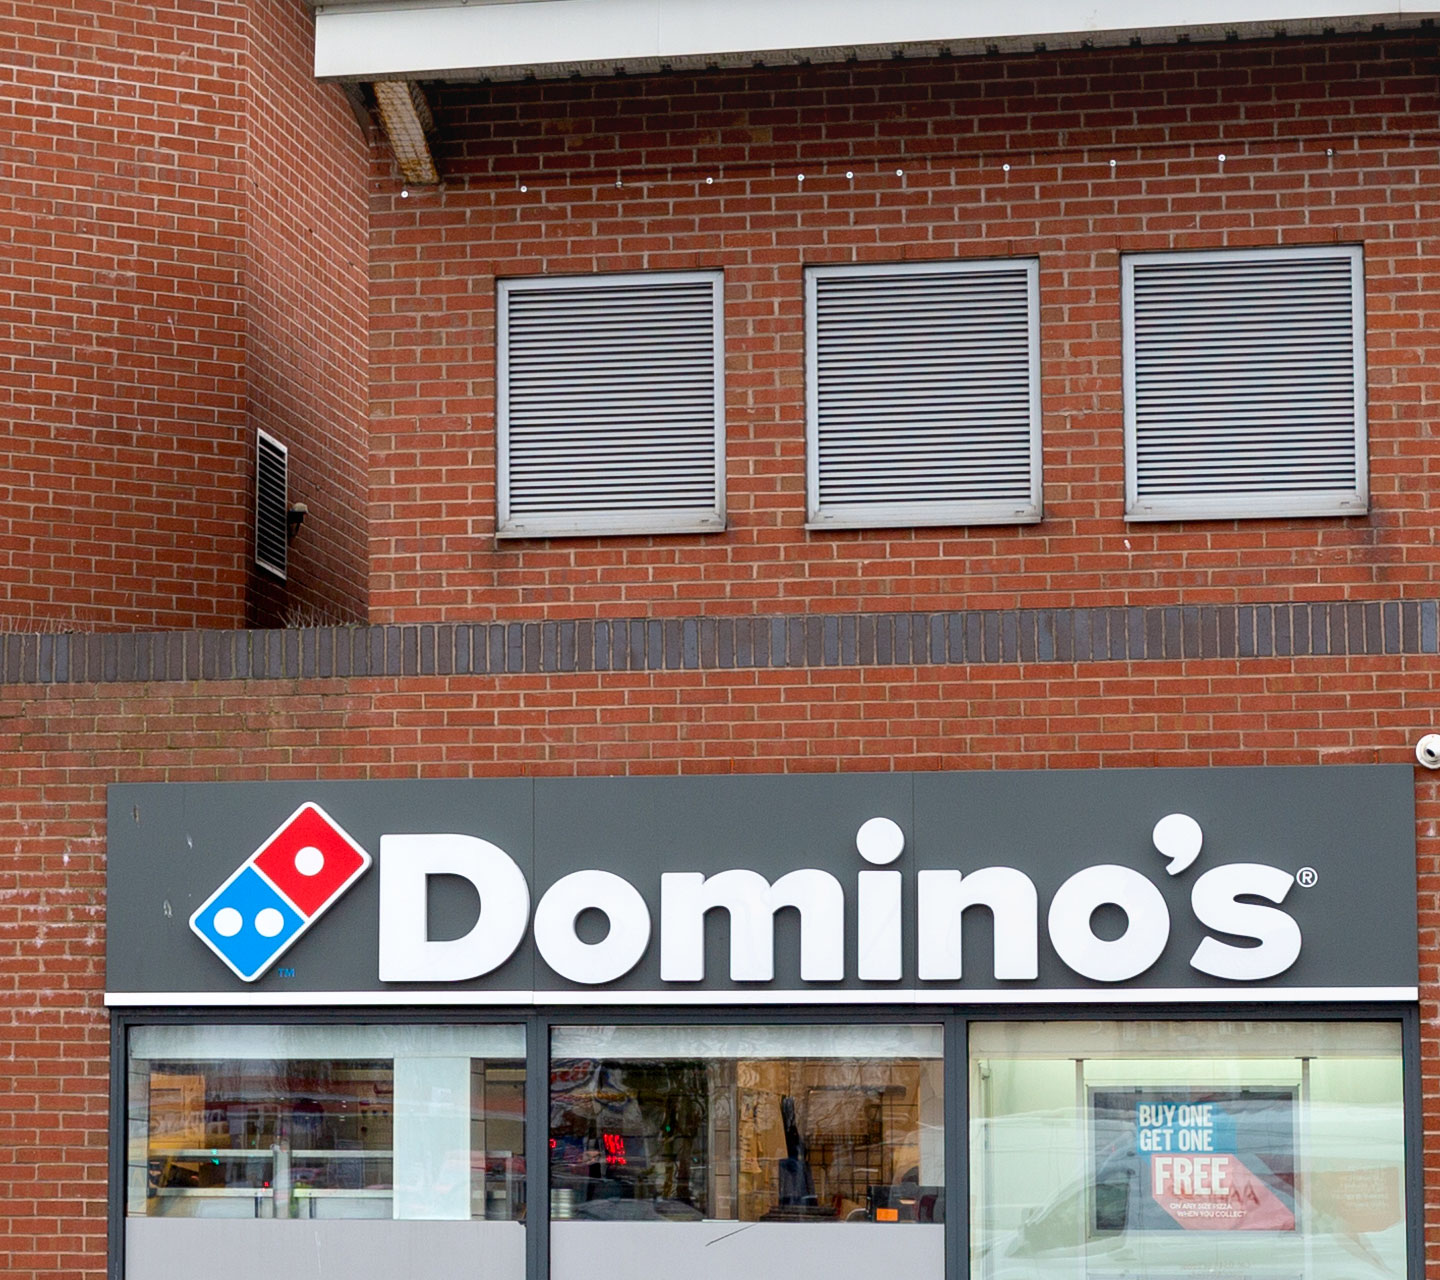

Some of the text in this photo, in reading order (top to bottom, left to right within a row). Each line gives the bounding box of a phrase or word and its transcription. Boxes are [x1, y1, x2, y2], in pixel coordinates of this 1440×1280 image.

[378, 813, 1302, 985] Domino's
[1139, 1104, 1213, 1127] BUY ONE
[1140, 1129, 1214, 1151] GET ONE
[1155, 1156, 1229, 1196] FREE
[1199, 1210, 1214, 1218] YOU
[1215, 1210, 1247, 1218] COLLECT
